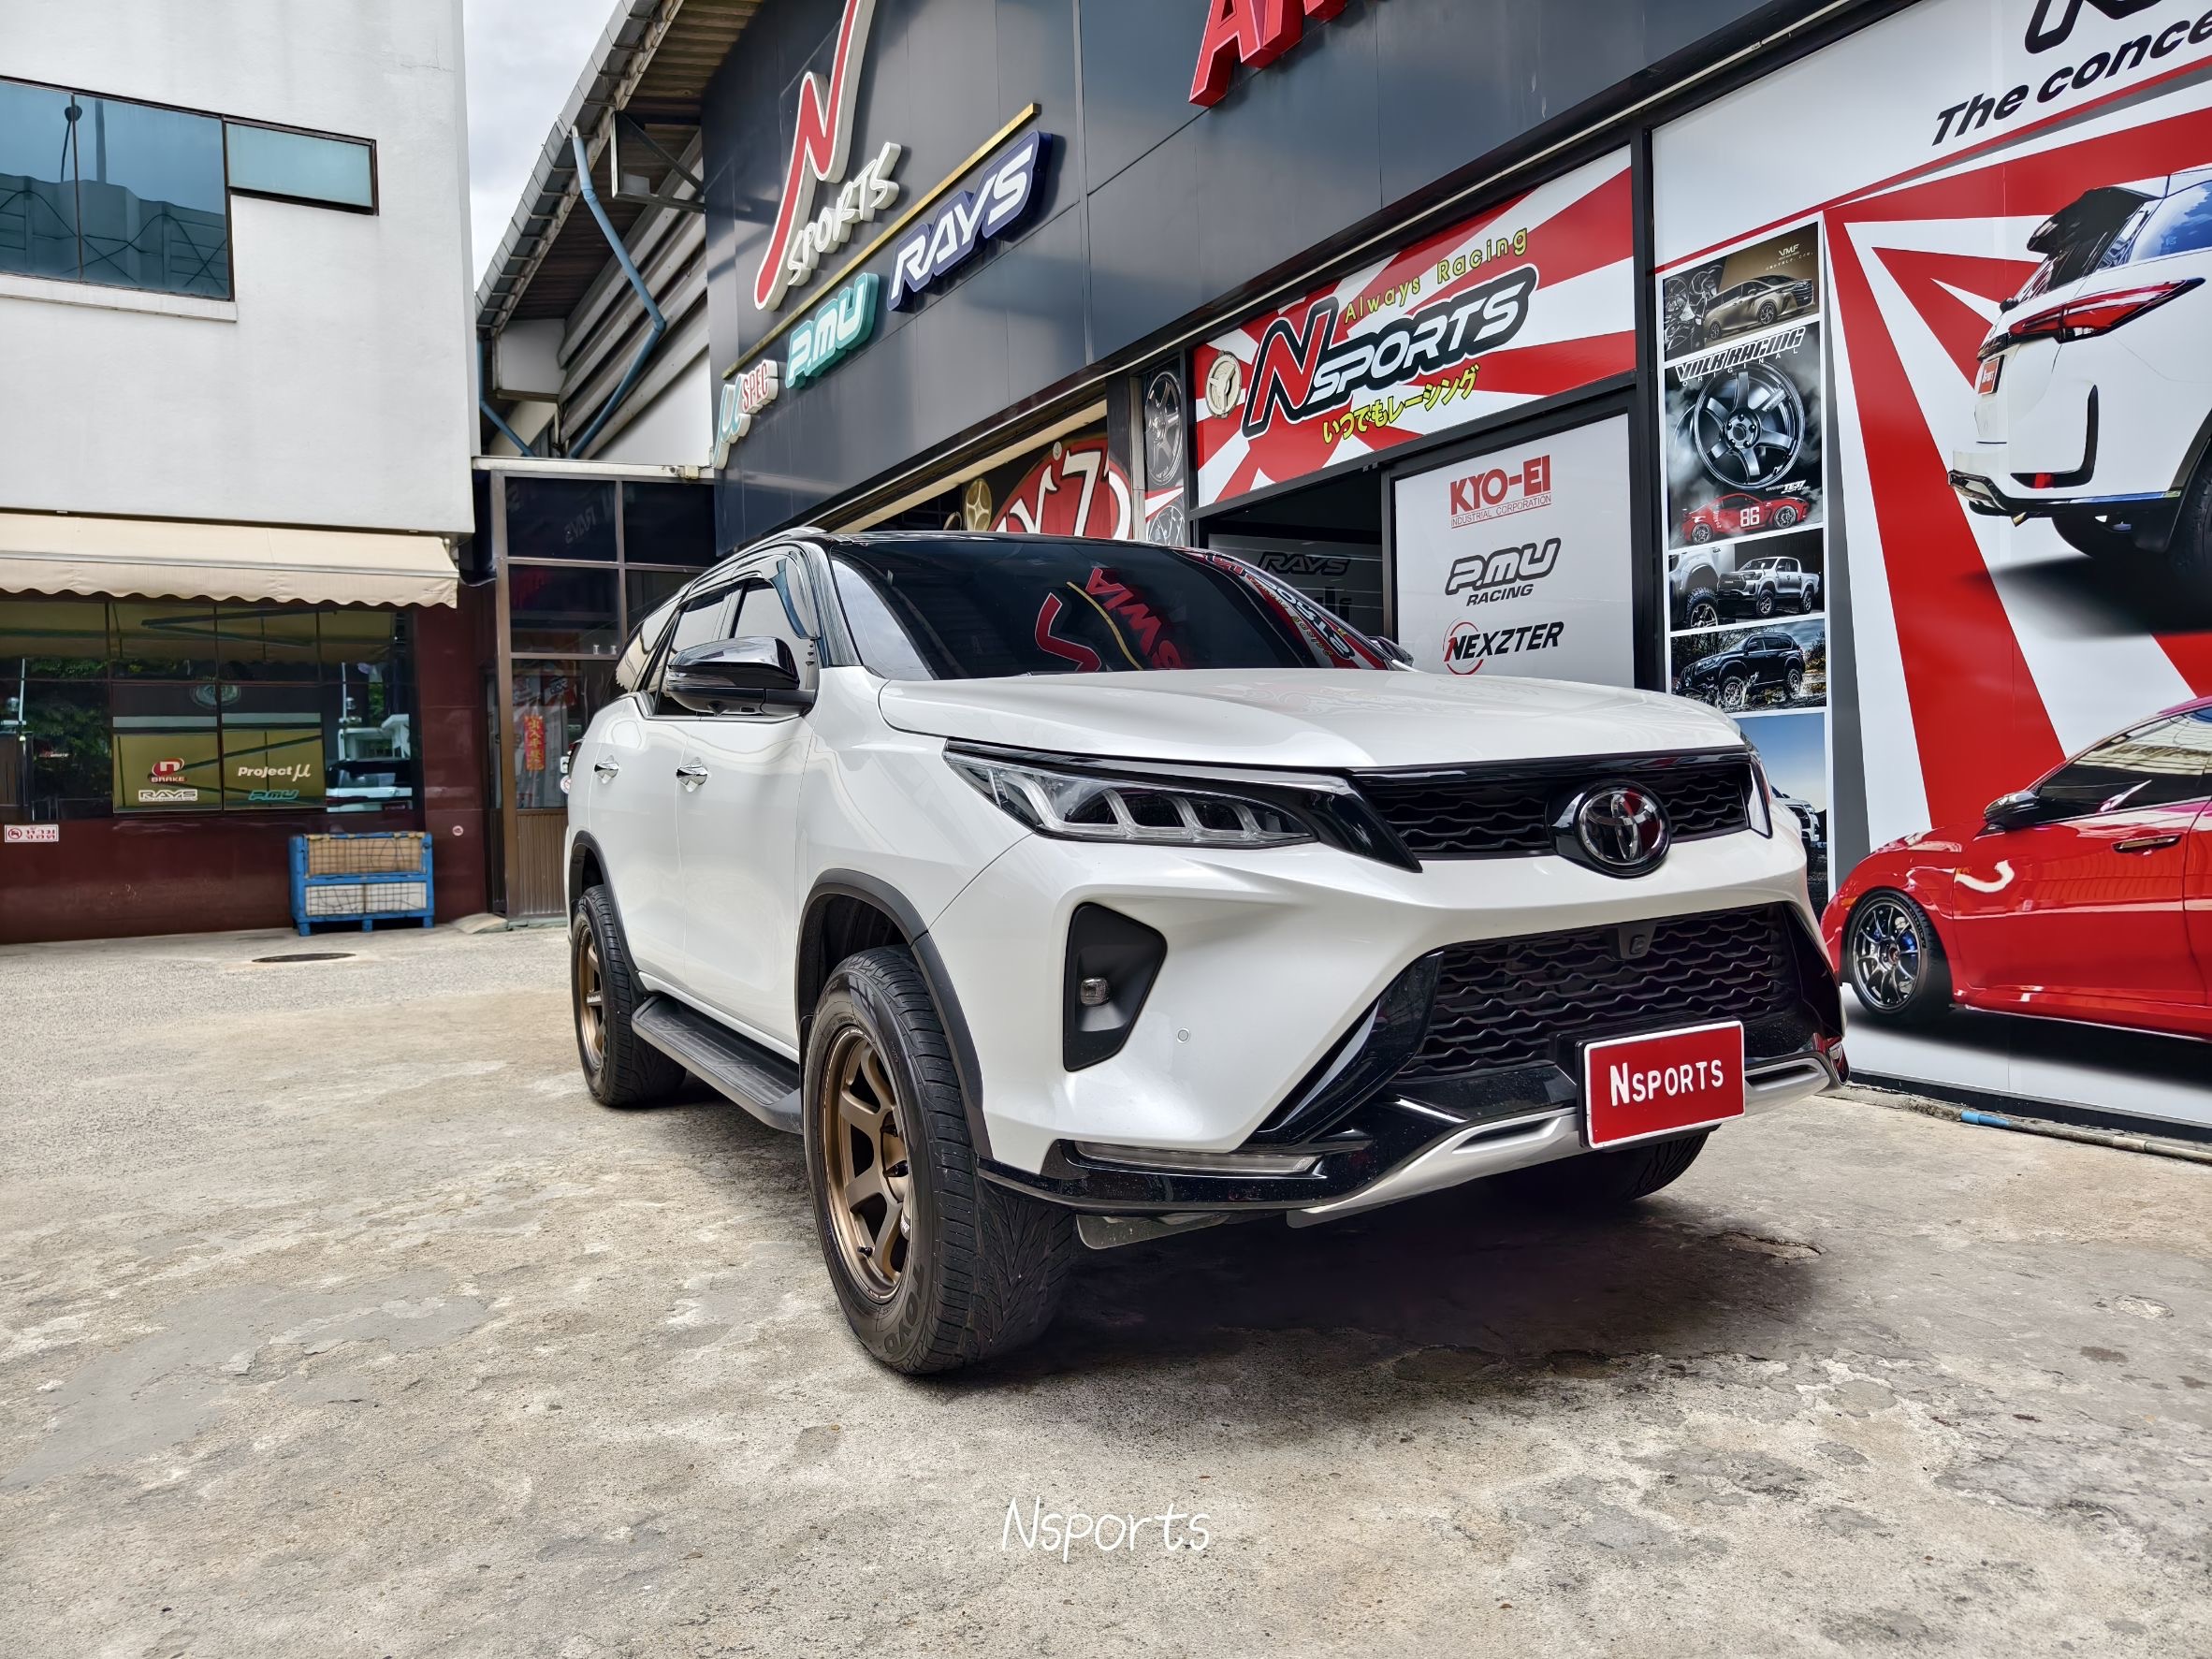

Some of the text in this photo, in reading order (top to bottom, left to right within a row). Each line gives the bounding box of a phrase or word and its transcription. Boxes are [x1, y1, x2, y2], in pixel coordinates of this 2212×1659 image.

[1931, 83, 2030, 147] The
[890, 142, 1037, 301] RAYS
[1344, 226, 1529, 325] Always Racing
[1675, 326, 1807, 383] VOLK RACING
[1681, 347, 1798, 387] ORIGINAL
[740, 360, 771, 414] SPEC
[1322, 362, 1481, 444] いつでもレーシング
[1449, 454, 1552, 516] KYO-EI
[1451, 493, 1552, 528] INDUSTRIAL CORPORATION
[1739, 506, 1760, 528] 86
[1259, 552, 1350, 576] RAYS
[1465, 583, 1535, 607] RACING
[1444, 620, 1565, 662] NEXZTER
[138, 789, 197, 800] RAYS
[237, 765, 293, 779] Project
[1608, 1059, 1724, 1107] NSPORTS
